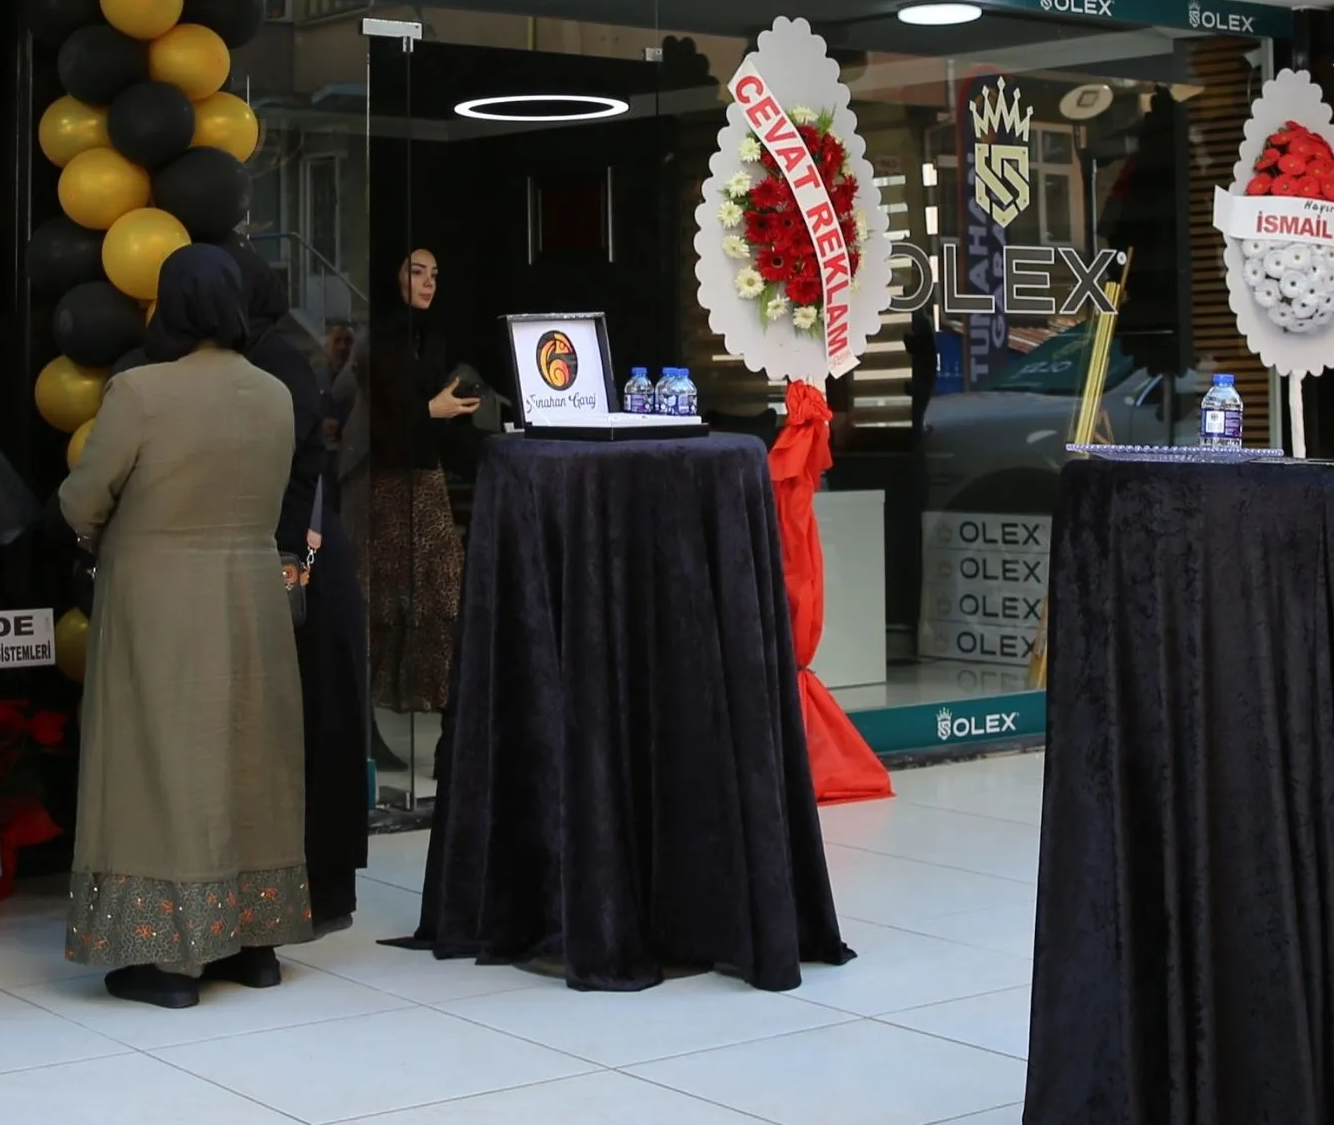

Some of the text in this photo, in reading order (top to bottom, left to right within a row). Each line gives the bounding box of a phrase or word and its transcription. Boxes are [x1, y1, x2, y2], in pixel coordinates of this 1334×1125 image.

[734, 74, 849, 358] CEVAT REKLAM
[1255, 210, 1333, 240] İSMAİL
[959, 521, 1041, 546] OLEX
[959, 557, 1042, 584] OLEX
[959, 593, 1041, 621] OLEX
